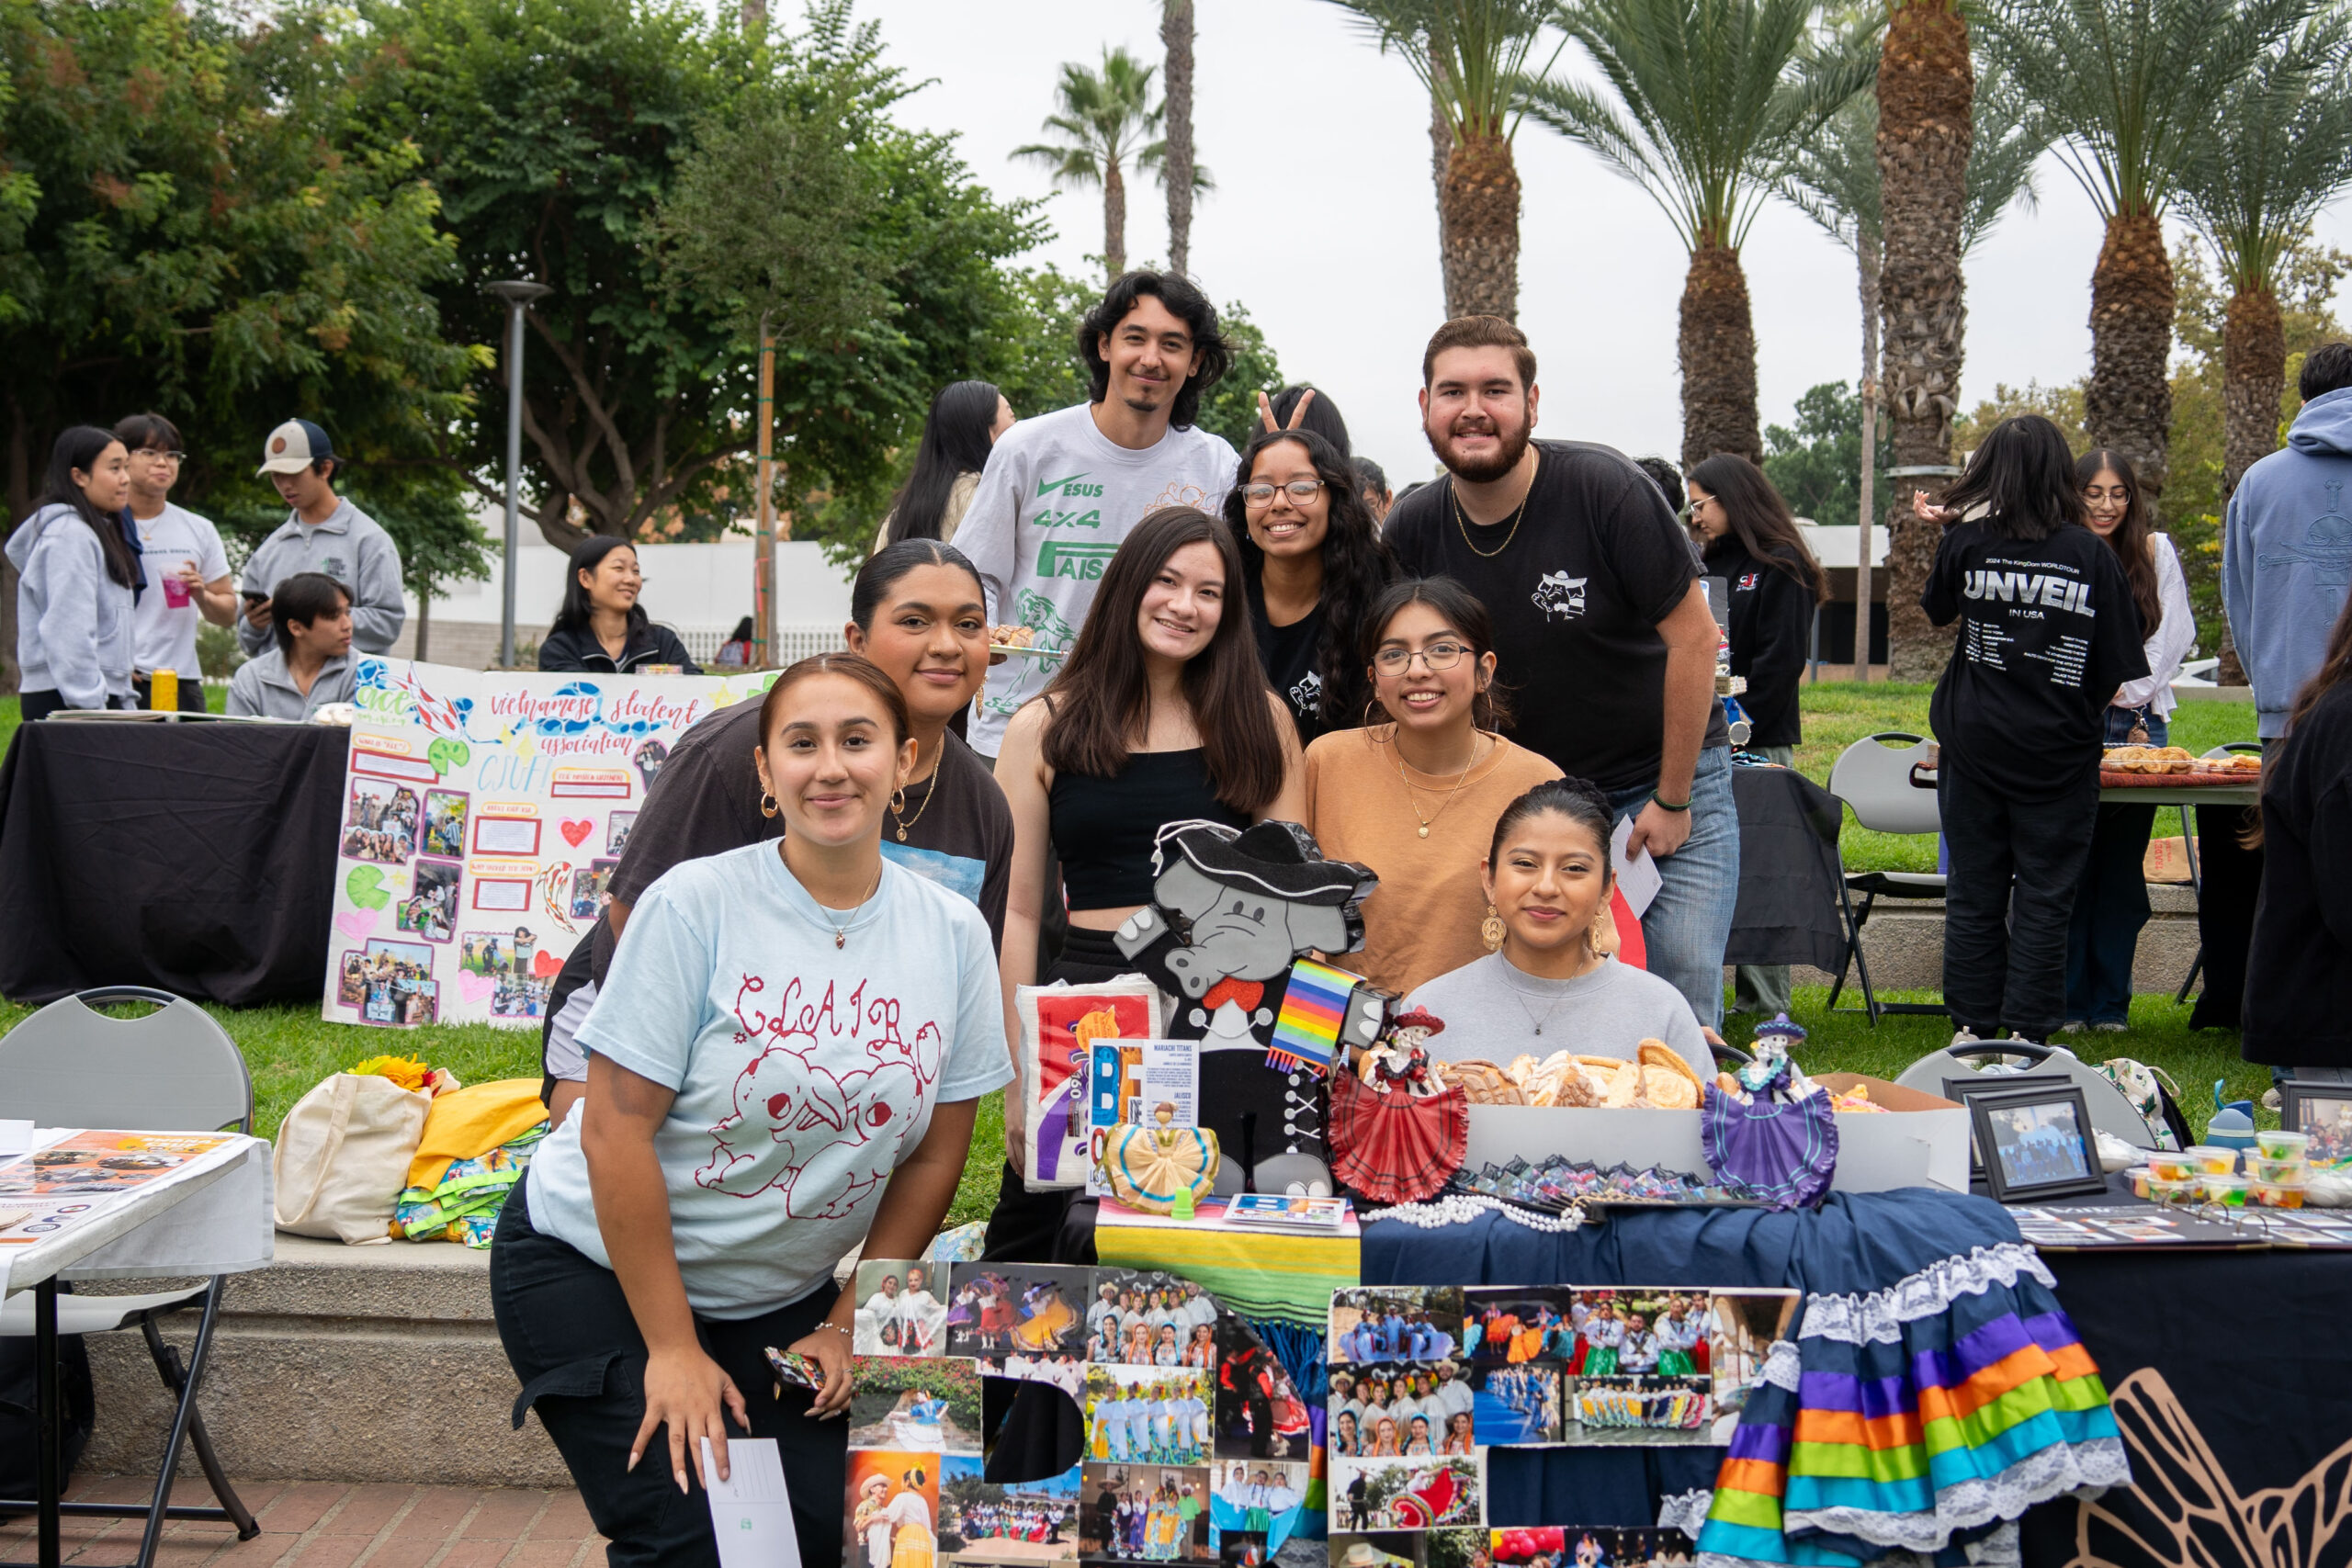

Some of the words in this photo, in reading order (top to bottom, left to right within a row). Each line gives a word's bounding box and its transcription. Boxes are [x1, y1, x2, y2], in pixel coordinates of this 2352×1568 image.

[1963, 570, 2096, 617] UNVEIL
[2008, 608, 2021, 617] IN
[2023, 610, 2045, 619] USA
[356, 686, 418, 715] ace
[491, 690, 596, 722] vietnamese
[610, 689, 700, 730] student
[540, 731, 637, 757] association
[1070, 1071, 1082, 1100] 160
